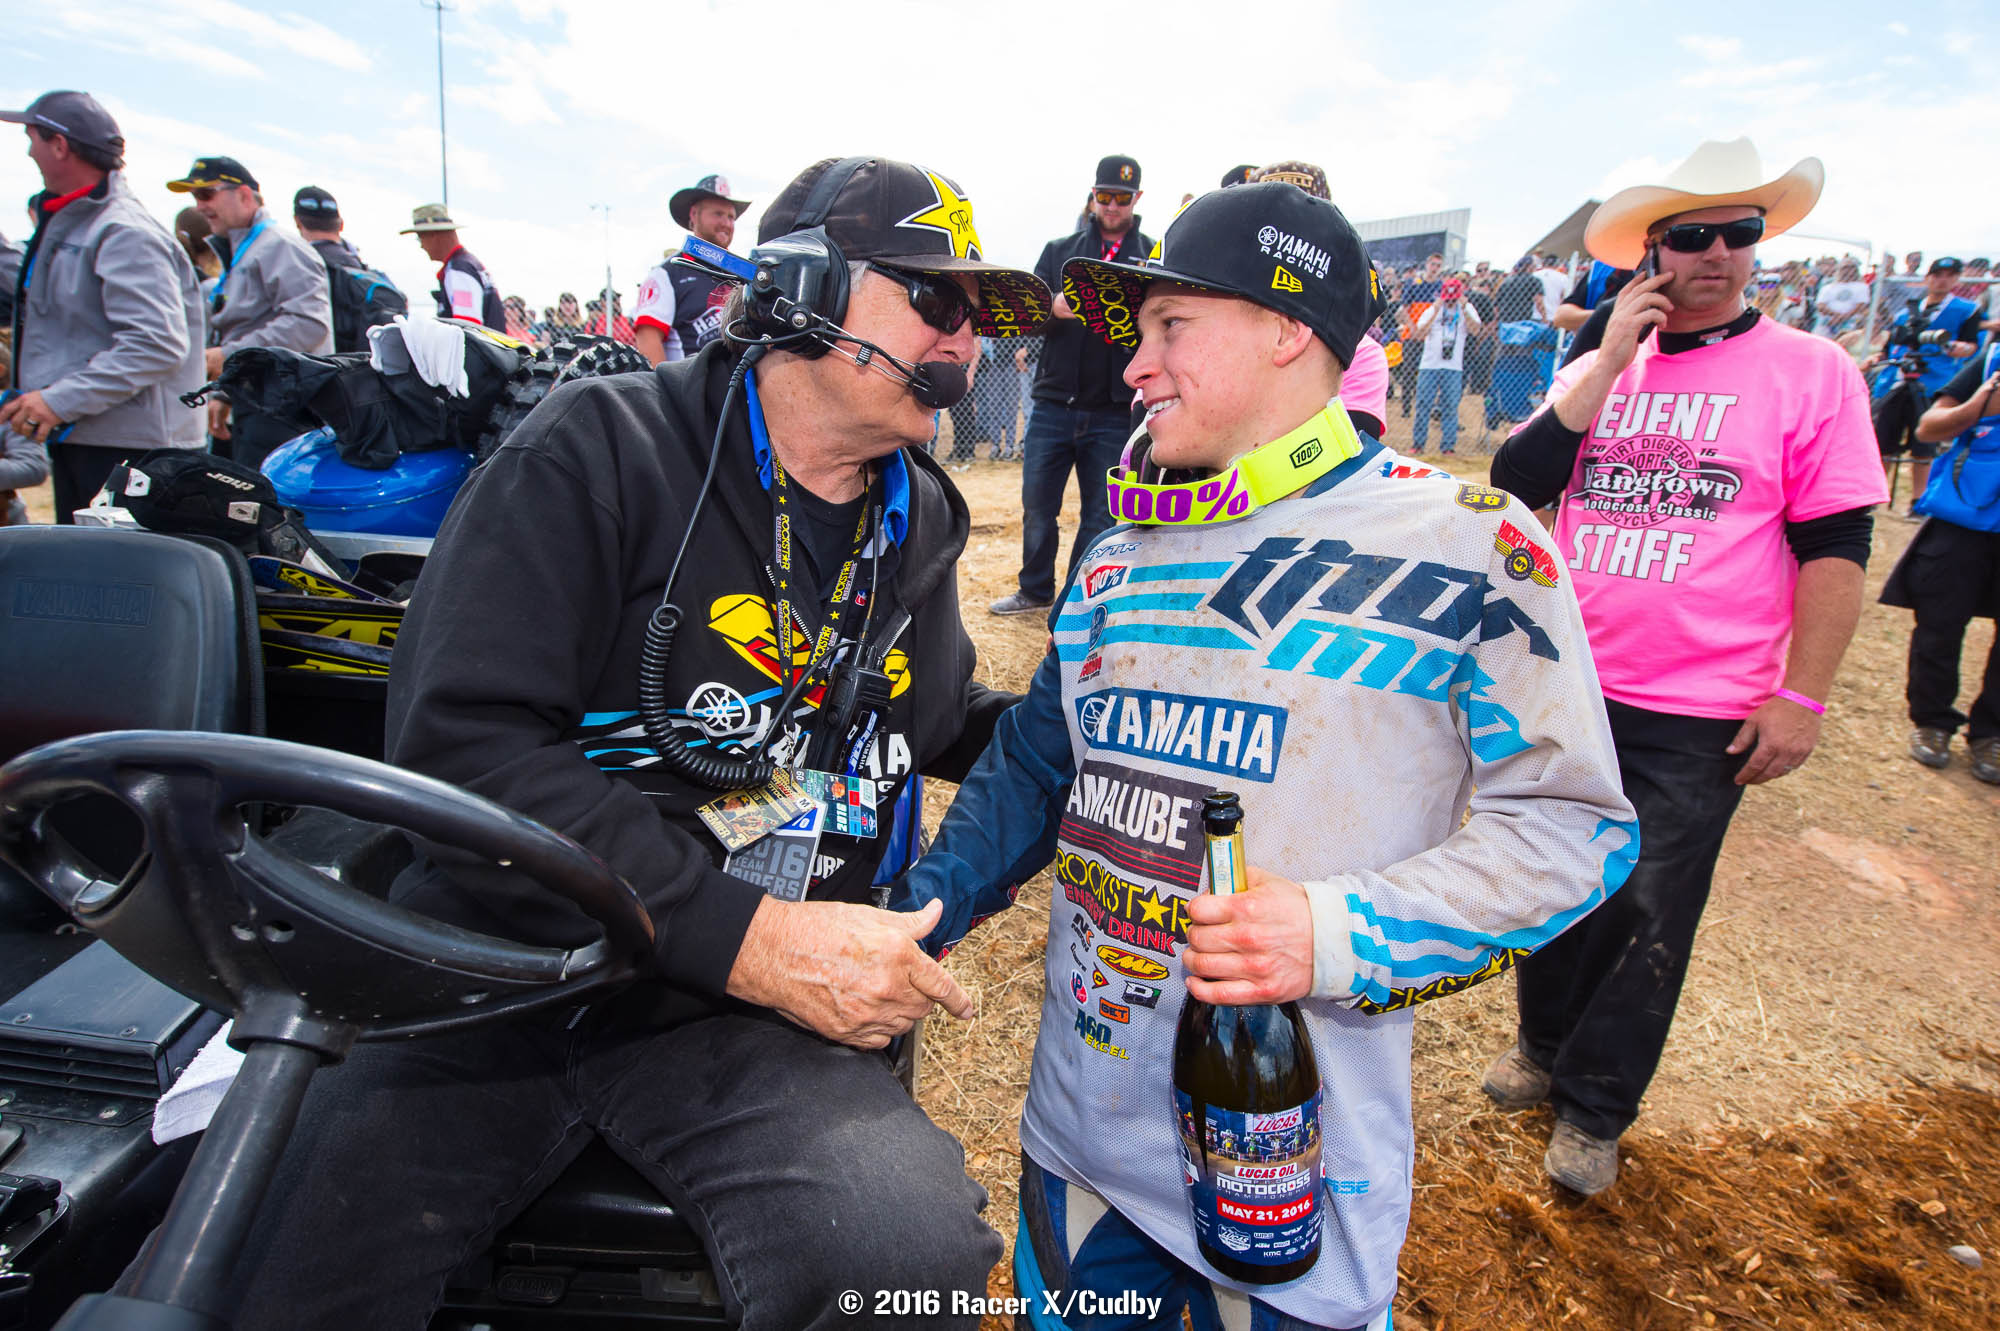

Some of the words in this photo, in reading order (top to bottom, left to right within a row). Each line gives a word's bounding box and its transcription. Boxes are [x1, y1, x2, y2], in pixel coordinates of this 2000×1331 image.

[693, 243, 724, 262] REGAN
[1260, 246, 1325, 279] RACING
[1277, 231, 1332, 275] YAMAHA
[1076, 281, 1107, 335] NERGY
[1594, 391, 1739, 442] EVENT
[1295, 443, 1322, 464] 100%
[1590, 444, 1608, 453] 20
[1700, 448, 1719, 457] 16
[1606, 440, 1636, 464] DIRT
[1641, 438, 1693, 469] DIGGERS
[206, 471, 255, 491] thor
[1107, 468, 1248, 523] 100%
[1463, 493, 1501, 506] 38
[1656, 502, 1718, 522] Classic
[780, 513, 791, 571] ROCKSTAR
[1568, 524, 1697, 584] STAFF
[832, 560, 853, 603] ROCKSTAR
[1090, 568, 1122, 595] 100%
[22, 582, 147, 626] YAMAHA
[781, 599, 791, 658] ROCKSTAR
[1096, 695, 1274, 775] YAMAHA
[857, 741, 874, 770] YAMAHA
[699, 804, 731, 839] PREMIER
[727, 833, 748, 849] 3
[837, 803, 848, 832] 2016
[1066, 773, 1193, 851] AMALUBE
[734, 856, 765, 873] TEAM
[1064, 884, 1105, 926] ENERGY
[1108, 915, 1177, 956] DRINK
[1098, 947, 1168, 977] FMF
[1075, 1008, 1113, 1043] A60
[1101, 1003, 1128, 1019] GET
[1085, 1034, 1130, 1060] EXCEL
[1253, 1112, 1300, 1132] LUCAS
[1216, 1171, 1311, 1195] MOTOCROSS
[1237, 1167, 1276, 1179] LUCAS
[1278, 1164, 1297, 1178] OIL
[1221, 1203, 1254, 1220] MAY
[1256, 1211, 1279, 1221] 21,
[1281, 1200, 1312, 1219] 2016
[1221, 1230, 1250, 1243] LUCAS
